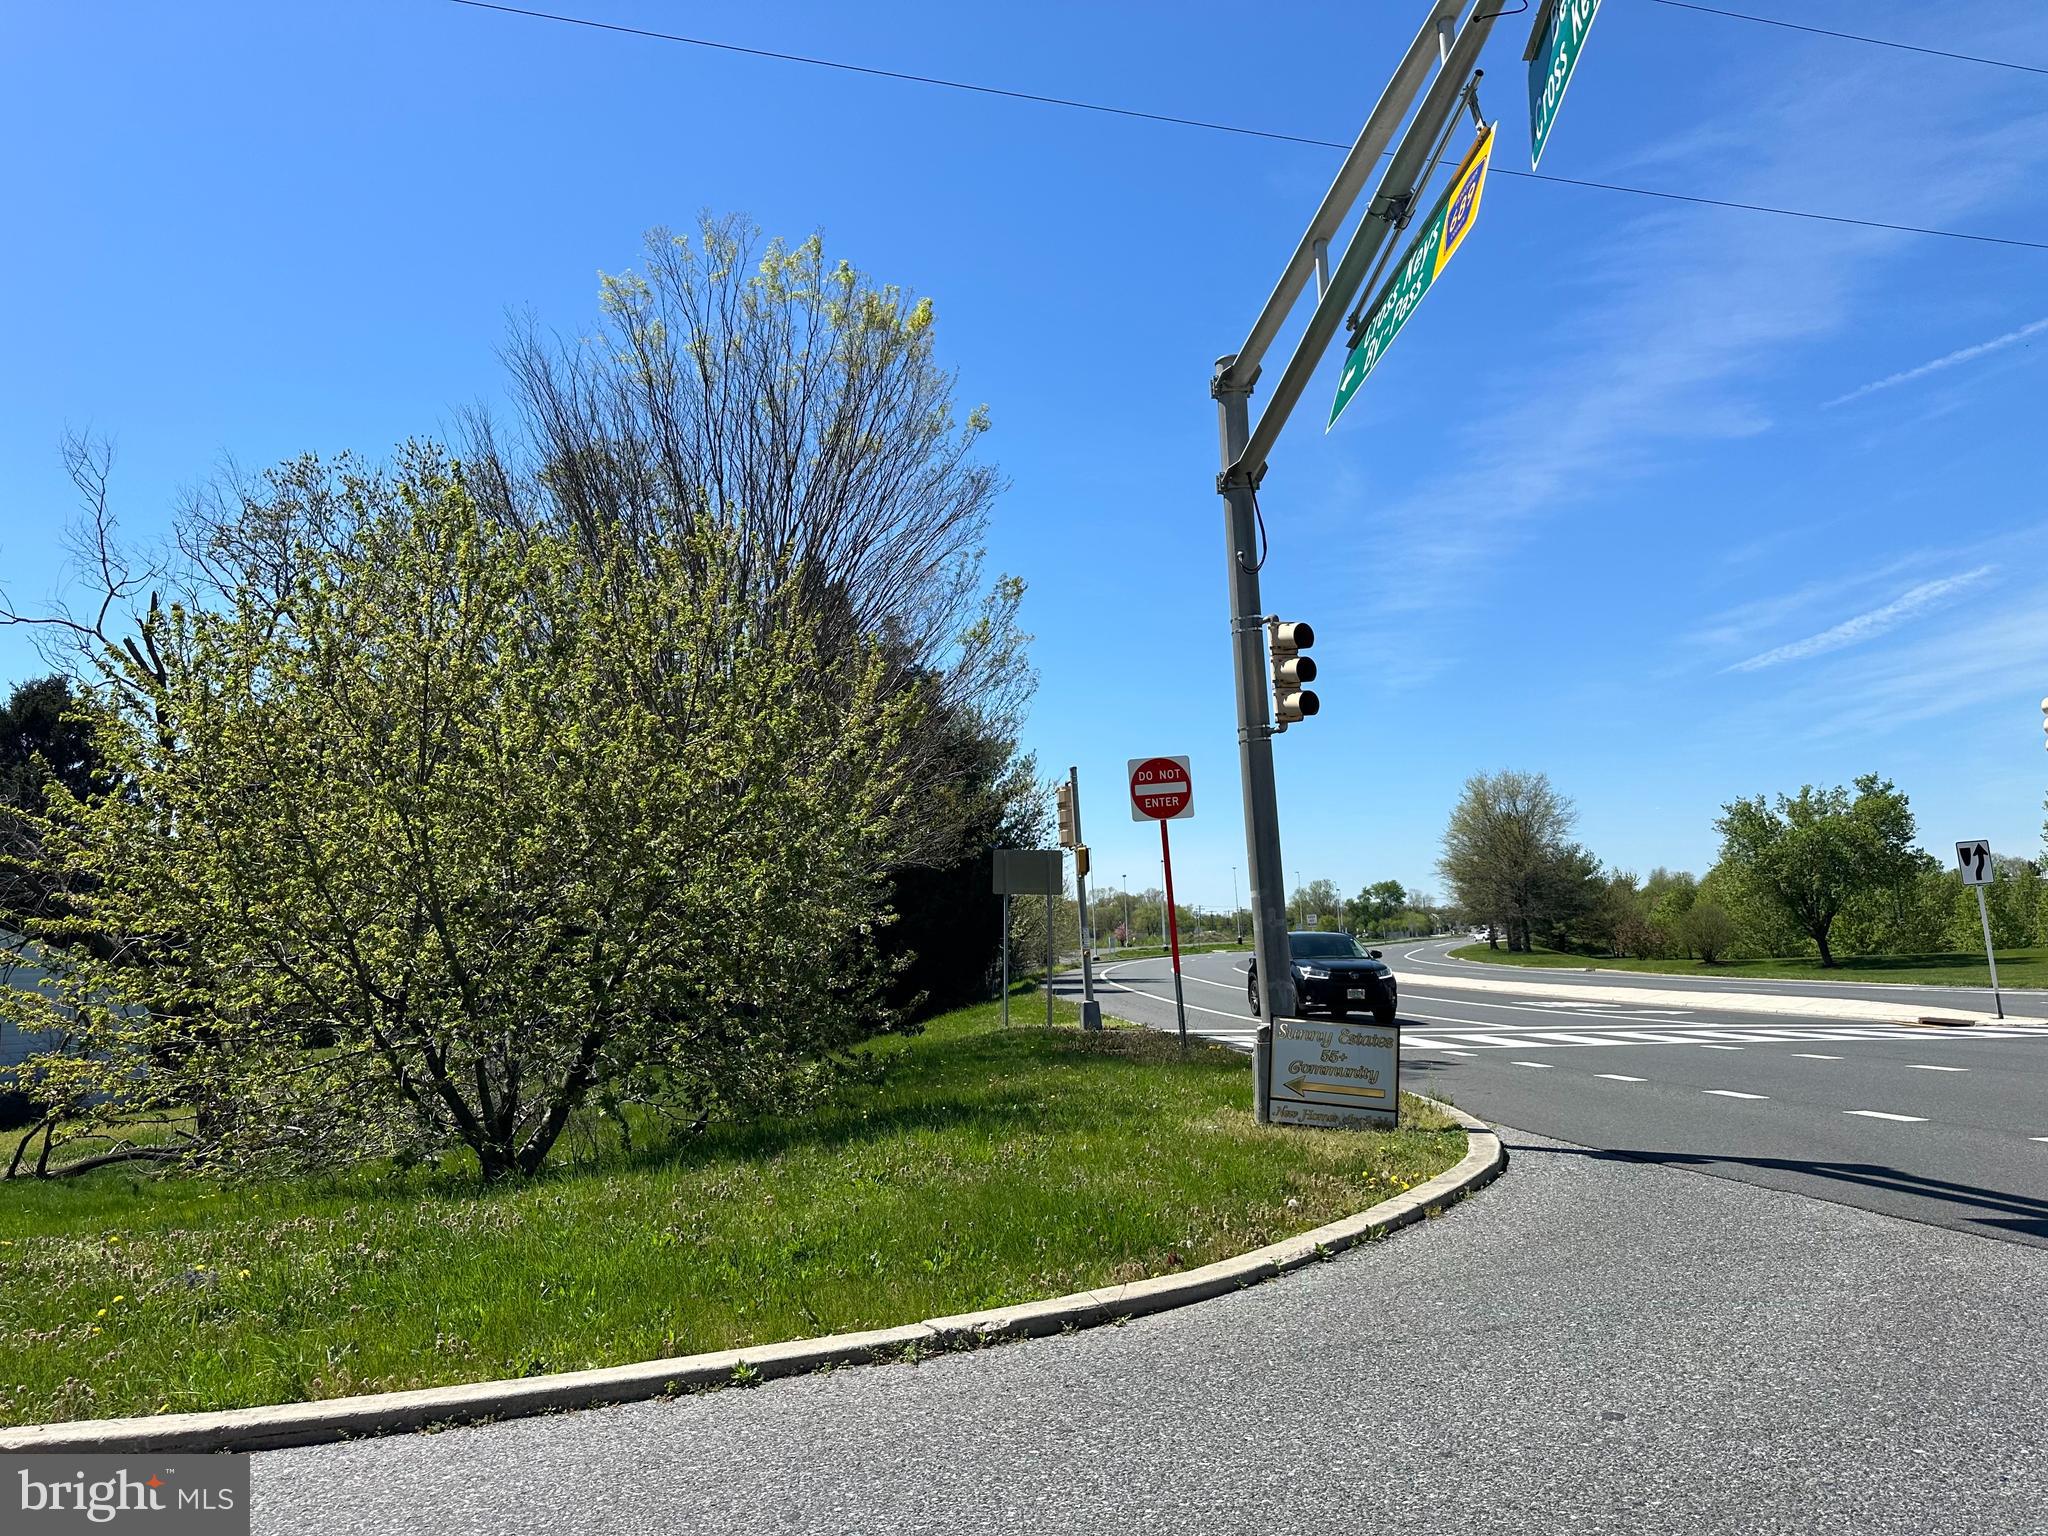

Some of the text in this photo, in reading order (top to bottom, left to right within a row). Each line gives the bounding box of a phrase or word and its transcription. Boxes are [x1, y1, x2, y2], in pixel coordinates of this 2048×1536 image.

[1535, 41, 1567, 140] Cross
[1571, 0, 1597, 46] Ke
[1449, 182, 1476, 233] 689
[1403, 221, 1440, 291] Keys
[1362, 273, 1424, 374] By-Pass
[1138, 769, 1180, 781] DO NOT
[1145, 796, 1179, 808] ENTER
[1279, 1023, 1394, 1049] Sunny Estates
[1320, 1049, 1348, 1063] 55+
[1288, 1060, 1379, 1084] Community
